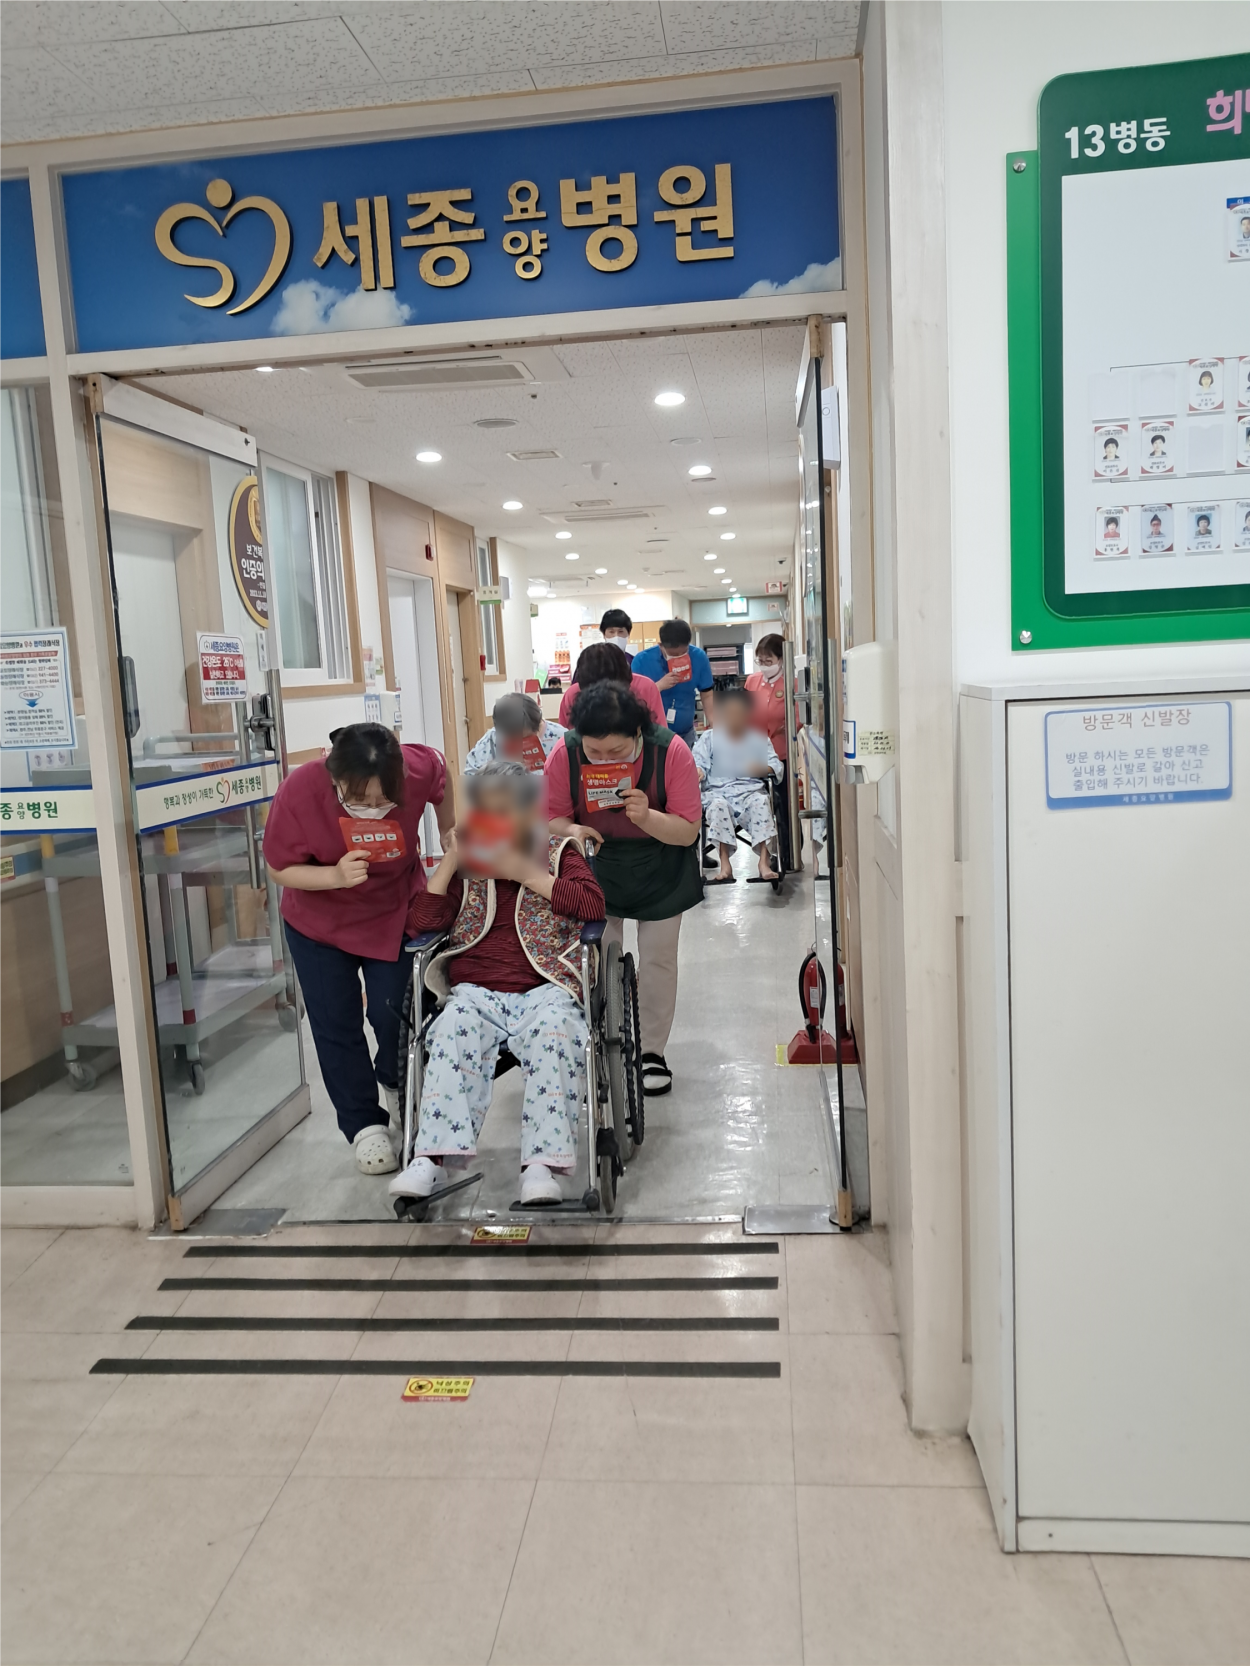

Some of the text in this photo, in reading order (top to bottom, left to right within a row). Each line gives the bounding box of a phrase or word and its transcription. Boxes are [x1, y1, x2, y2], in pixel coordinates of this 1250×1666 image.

[1064, 117, 1171, 159] 13병동
[1083, 708, 1192, 731] 방문객 신발장
[1066, 744, 1210, 764] 방문 하시는 모든 방문객은
[1072, 759, 1204, 777] 실내용 신발로 갈아 신고
[1073, 773, 1204, 791] 출입해 주시기 바랍니다.
[199, 787, 214, 801] 가득한
